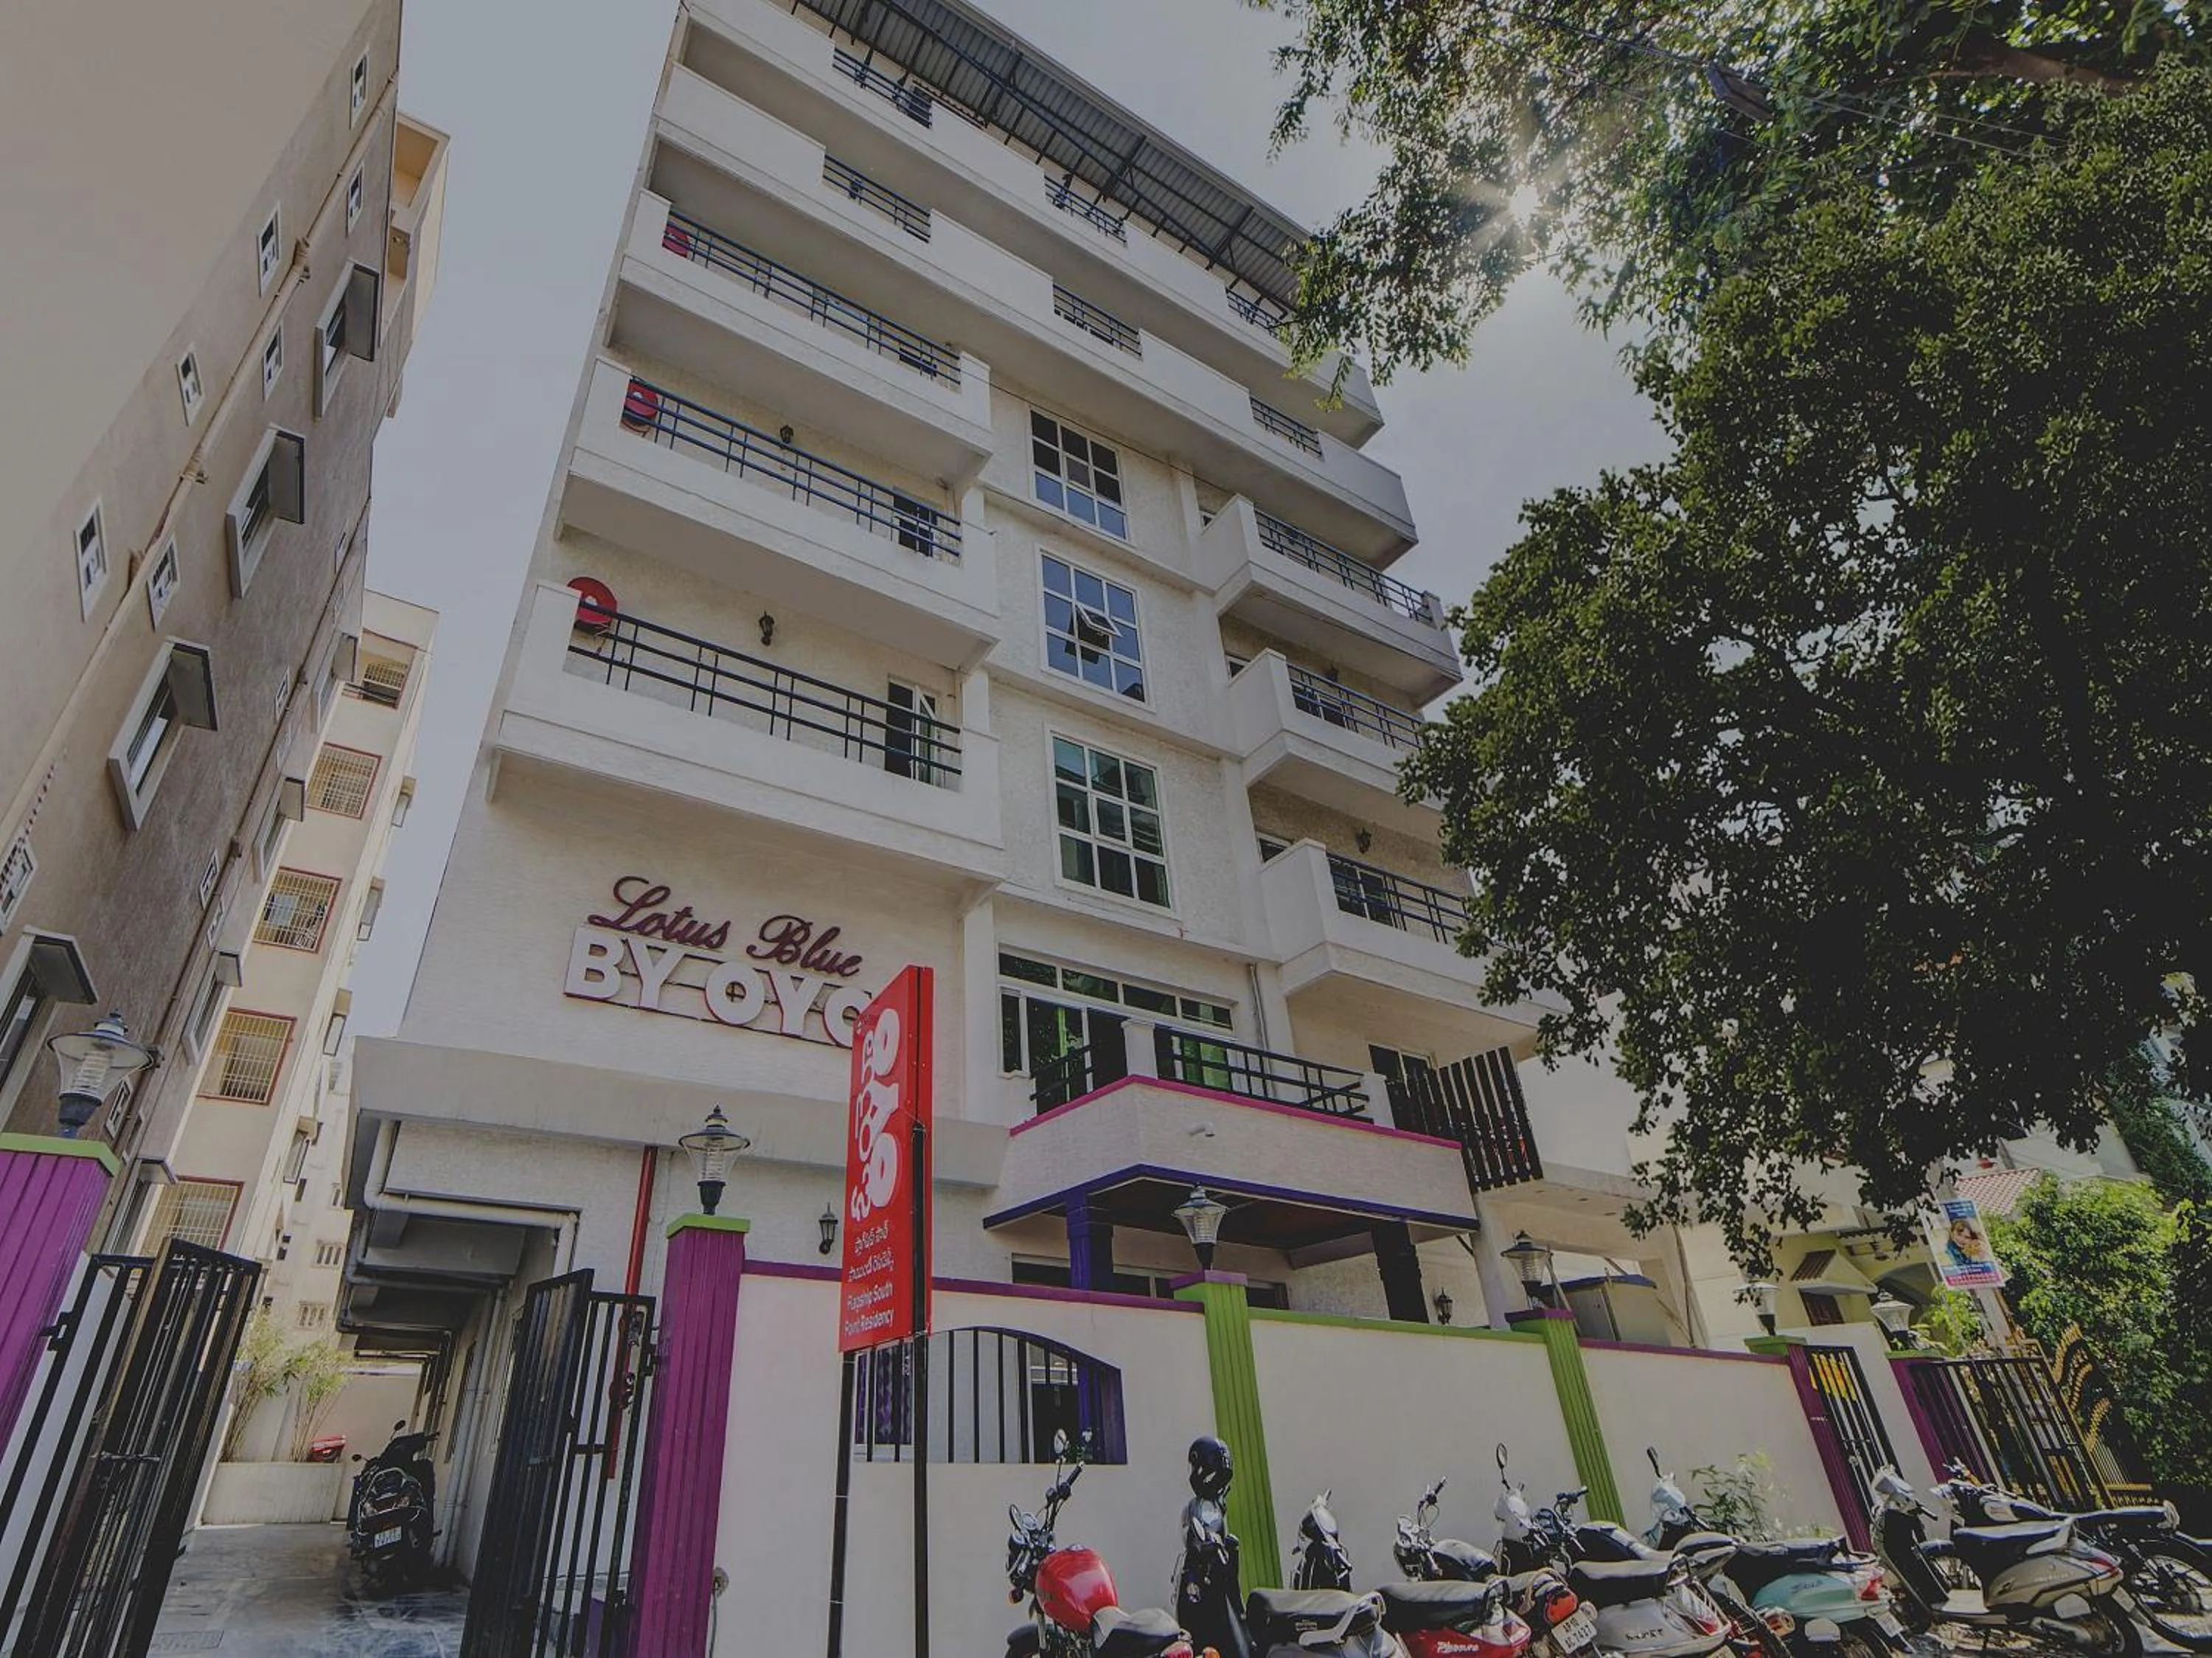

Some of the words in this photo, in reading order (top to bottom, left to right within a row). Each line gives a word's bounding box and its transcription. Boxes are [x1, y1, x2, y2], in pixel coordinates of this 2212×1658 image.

[588, 875, 731, 948] Lotus
[746, 915, 863, 977] Blue
[564, 924, 678, 1010] BY
[705, 960, 873, 1048] OYO
[866, 1007, 900, 1208] OYO
[861, 1308, 894, 1331] Residency
